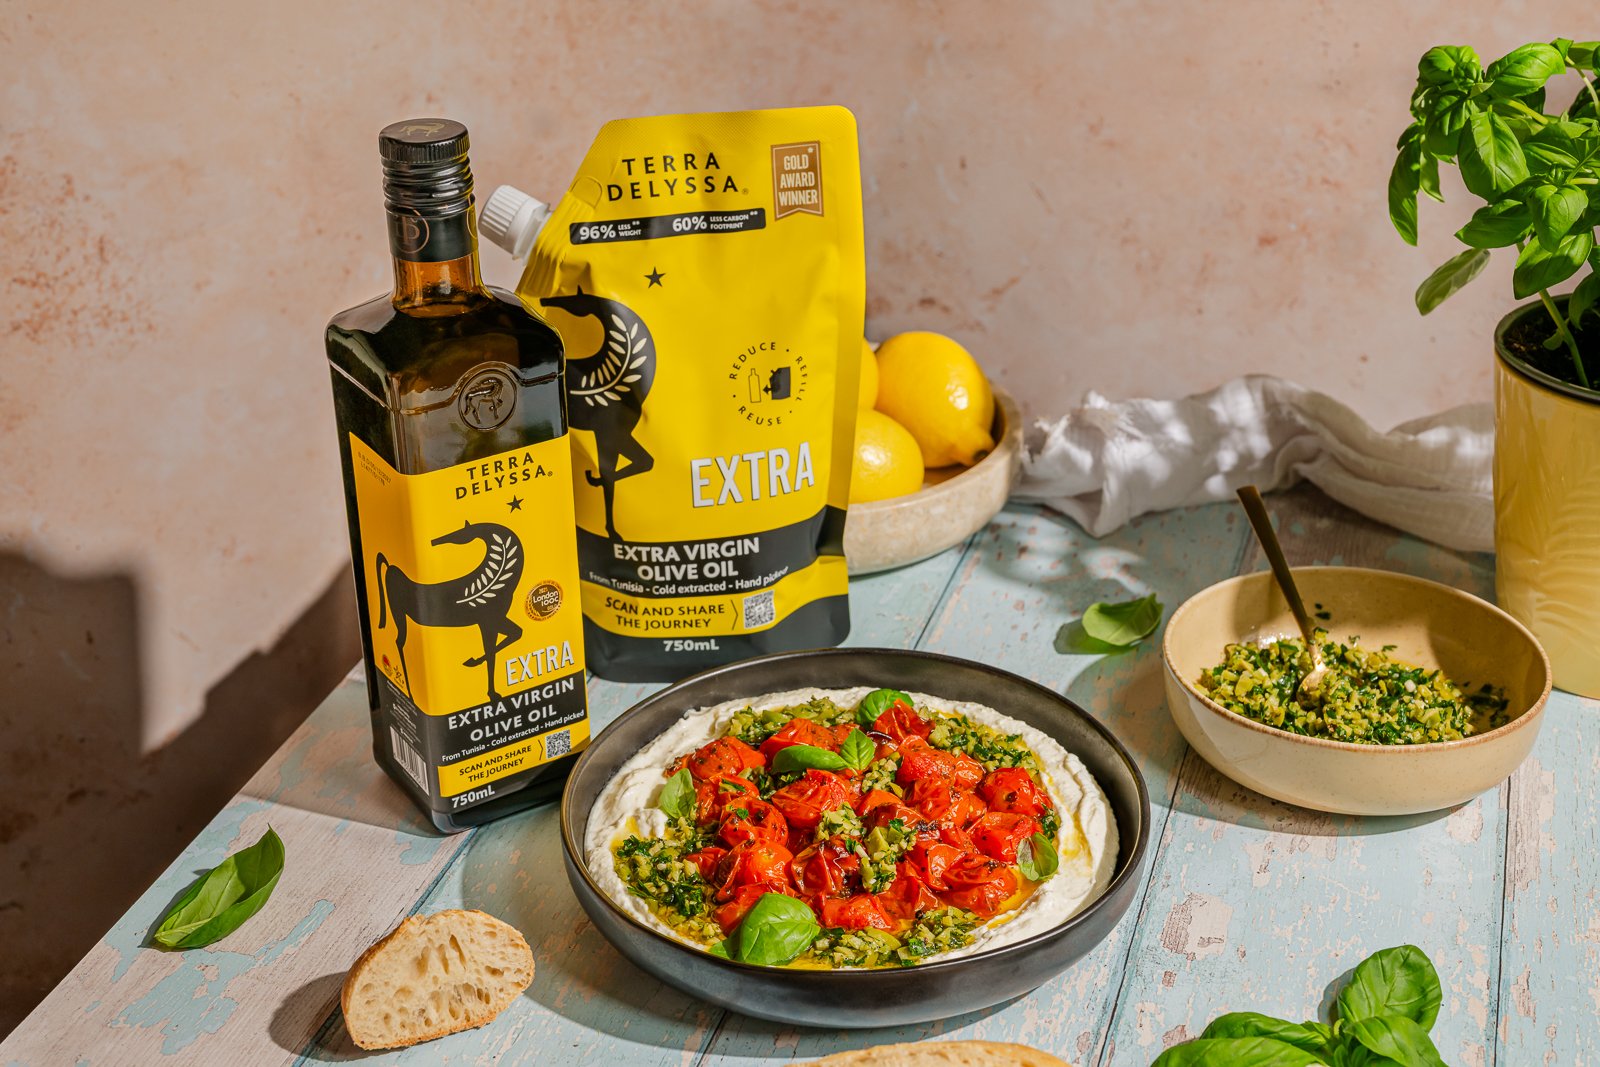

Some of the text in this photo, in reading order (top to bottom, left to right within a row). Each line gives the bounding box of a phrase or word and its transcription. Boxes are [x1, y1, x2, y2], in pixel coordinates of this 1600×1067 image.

[622, 152, 721, 176] TERRA
[783, 154, 809, 170] GOLD
[780, 172, 815, 189] AWARD
[778, 189, 818, 206] WINNER
[579, 224, 616, 240] 96%
[619, 229, 642, 237] WEIGHT
[672, 215, 707, 232] 60%
[710, 222, 744, 230] FOOTPRINT
[729, 342, 776, 380] REDUCE
[795, 356, 808, 401] REFILL
[738, 405, 782, 426] REUSE
[466, 452, 535, 480] TERRA
[691, 441, 815, 508] EXTRA
[613, 537, 760, 563] EXTRA VIRGIN
[589, 571, 611, 586] From
[611, 578, 644, 594] Tunisia
[652, 584, 676, 595] Cold
[678, 581, 726, 594] extracted
[735, 575, 762, 590] Hand
[762, 566, 789, 588] picked
[637, 560, 739, 582] OLIVE OIL
[533, 590, 559, 604] London
[604, 596, 726, 616] SCAN AND SHARE
[615, 615, 712, 631] THE JOURNEY
[663, 638, 720, 652] 750mL
[506, 640, 575, 686] EXTRA
[448, 677, 575, 730] EXTRA VIRGIN
[470, 704, 558, 742] OLIVE OIL
[441, 751, 461, 763] From
[461, 743, 486, 758] Tunisia
[491, 736, 506, 748] Cold
[507, 724, 540, 743] extracted
[544, 717, 563, 730] Hand
[563, 709, 585, 728] picked
[459, 745, 532, 776] SCAN AND SHARE
[468, 757, 525, 783] THE JOURNEY
[451, 784, 495, 808] 750mL
